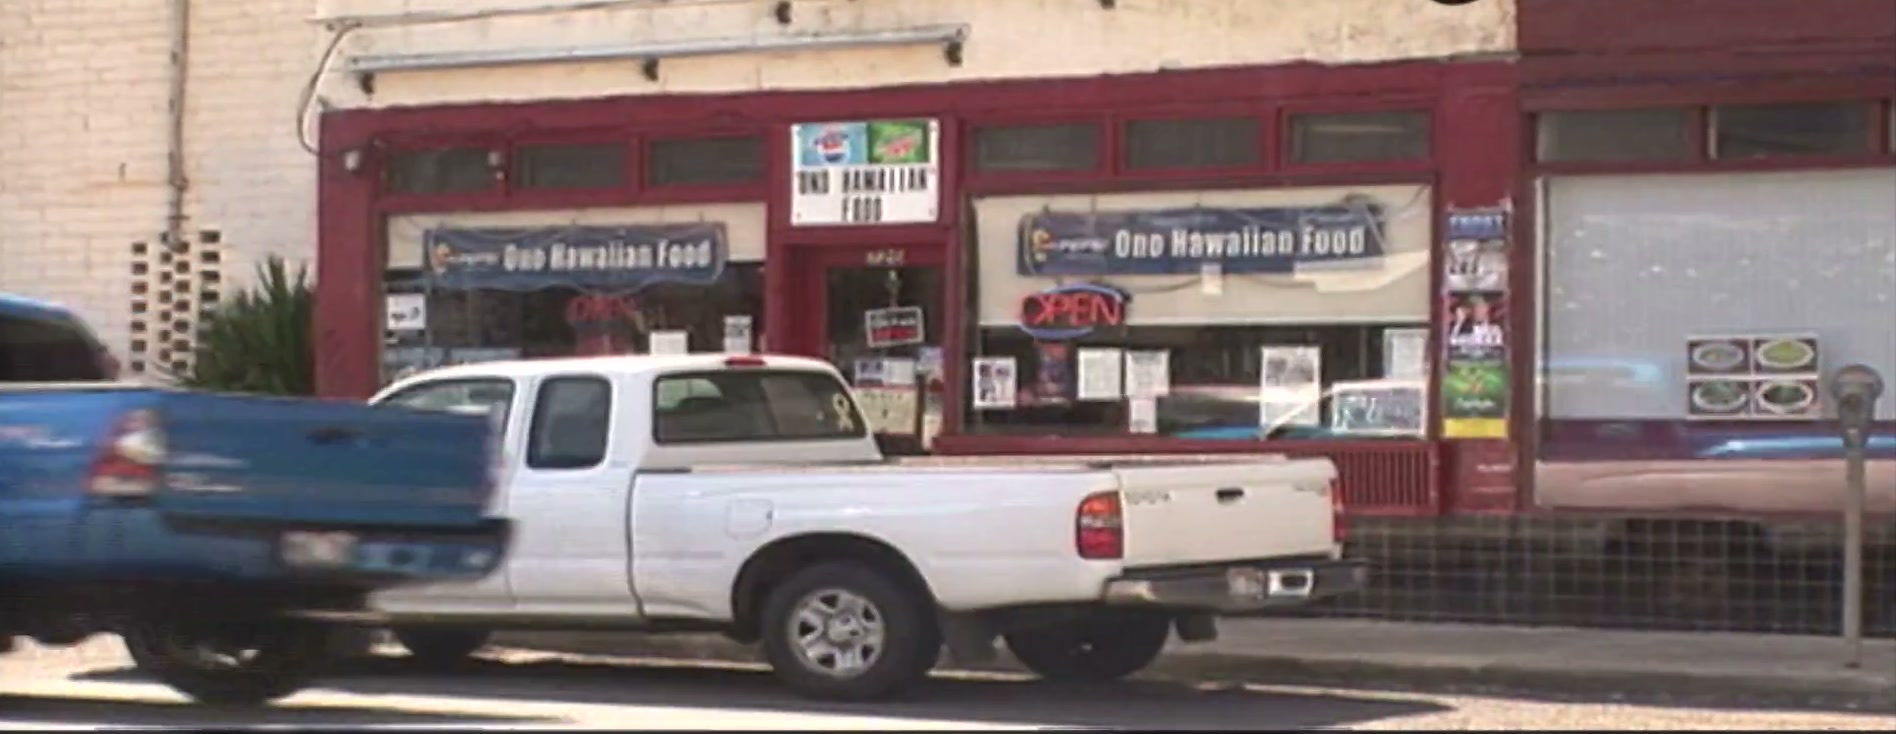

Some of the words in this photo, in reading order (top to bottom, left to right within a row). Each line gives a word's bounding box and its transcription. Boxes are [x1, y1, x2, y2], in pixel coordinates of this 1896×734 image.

[842, 168, 927, 192] HAWAIIAN
[841, 196, 883, 222] FOOD
[503, 243, 547, 272] Ono
[550, 242, 653, 272] Hawaiian
[656, 238, 711, 269] Food
[1114, 230, 1164, 259] Ono
[1171, 227, 1294, 259] Hawaiian
[1301, 226, 1366, 255] Food
[1021, 293, 1122, 328] OPEN
